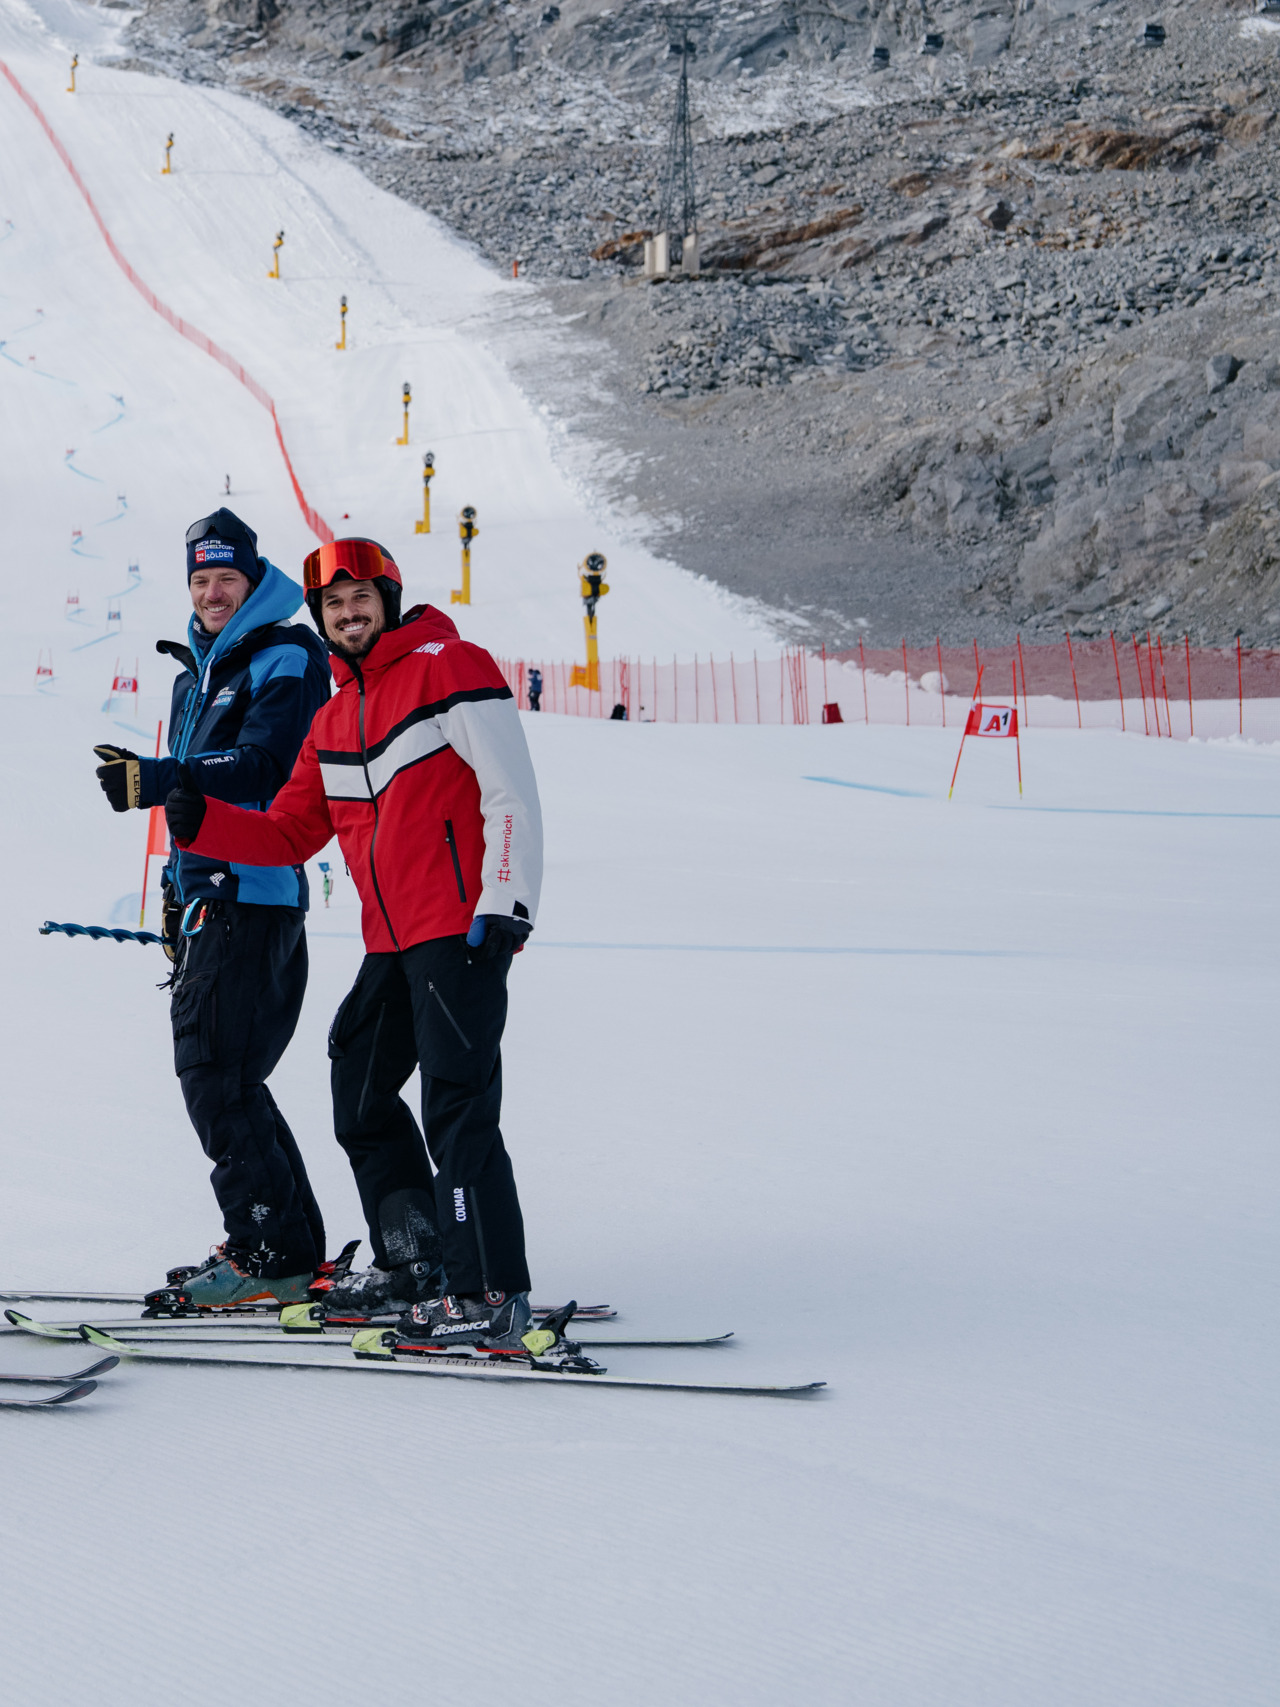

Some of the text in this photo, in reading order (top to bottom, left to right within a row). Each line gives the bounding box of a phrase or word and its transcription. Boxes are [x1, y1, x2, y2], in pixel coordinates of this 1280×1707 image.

[206, 551, 233, 560] SÖLDEN
[983, 711, 1010, 732] A1
[497, 814, 513, 883] #skiverrückt
[453, 1187, 467, 1222] COLMAR
[431, 1320, 490, 1337] NORDICA
